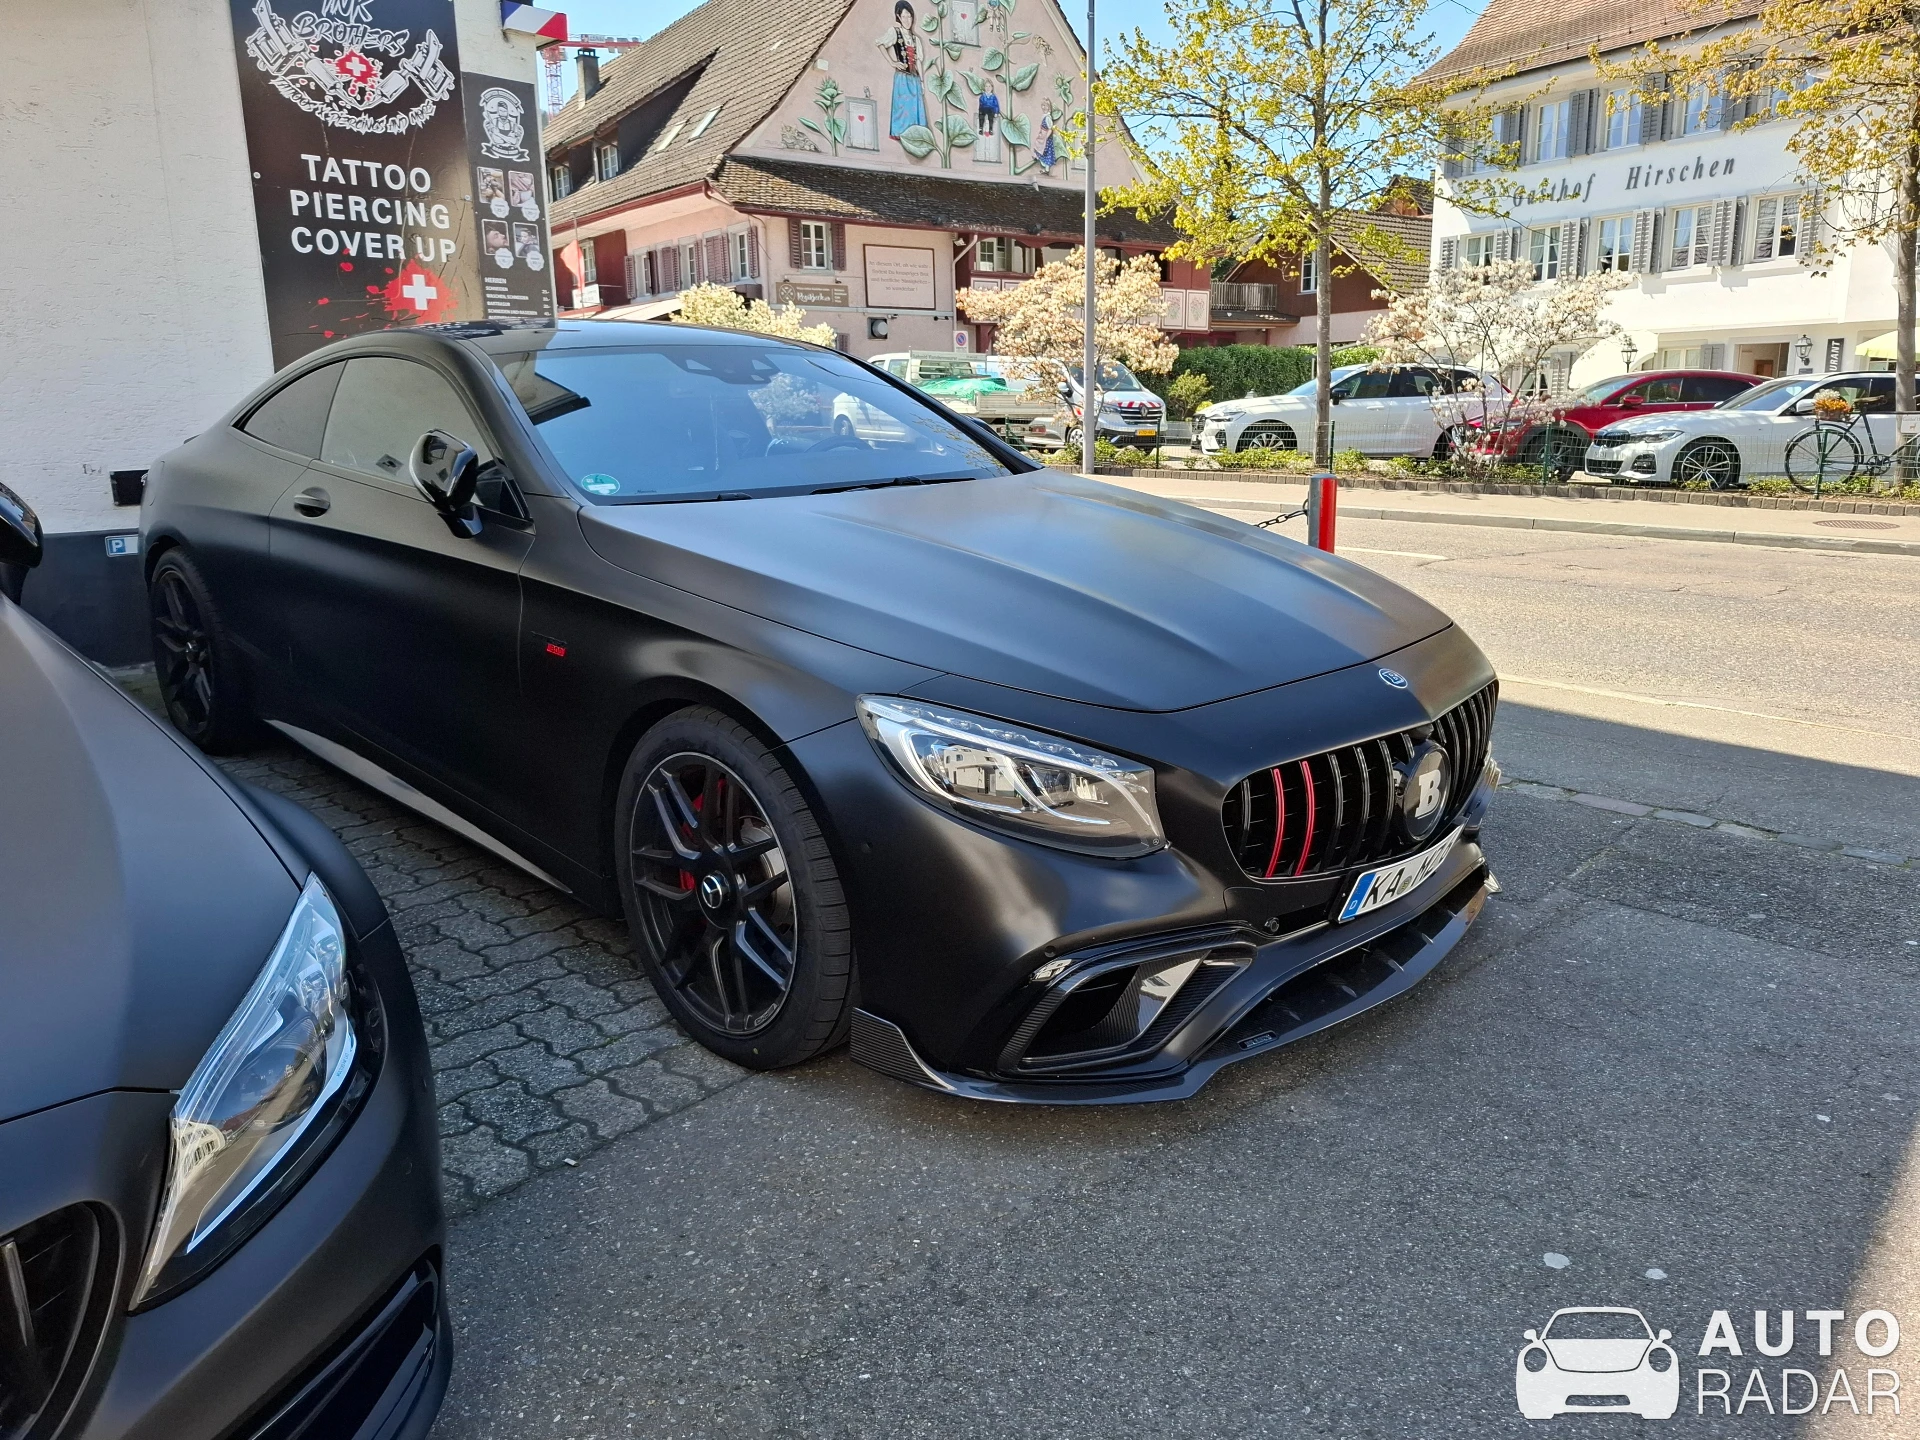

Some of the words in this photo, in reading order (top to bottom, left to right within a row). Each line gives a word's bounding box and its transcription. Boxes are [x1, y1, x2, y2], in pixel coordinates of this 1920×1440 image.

[291, 11, 410, 57] BROTHERS
[300, 153, 432, 193] TATTOO
[1624, 155, 1736, 190] Hirschen
[289, 189, 450, 229] PIERCING
[291, 226, 406, 260] COVER
[416, 236, 456, 263] UP
[111, 540, 123, 553] P
[1415, 769, 1441, 819] B
[1361, 866, 1406, 909] KA
